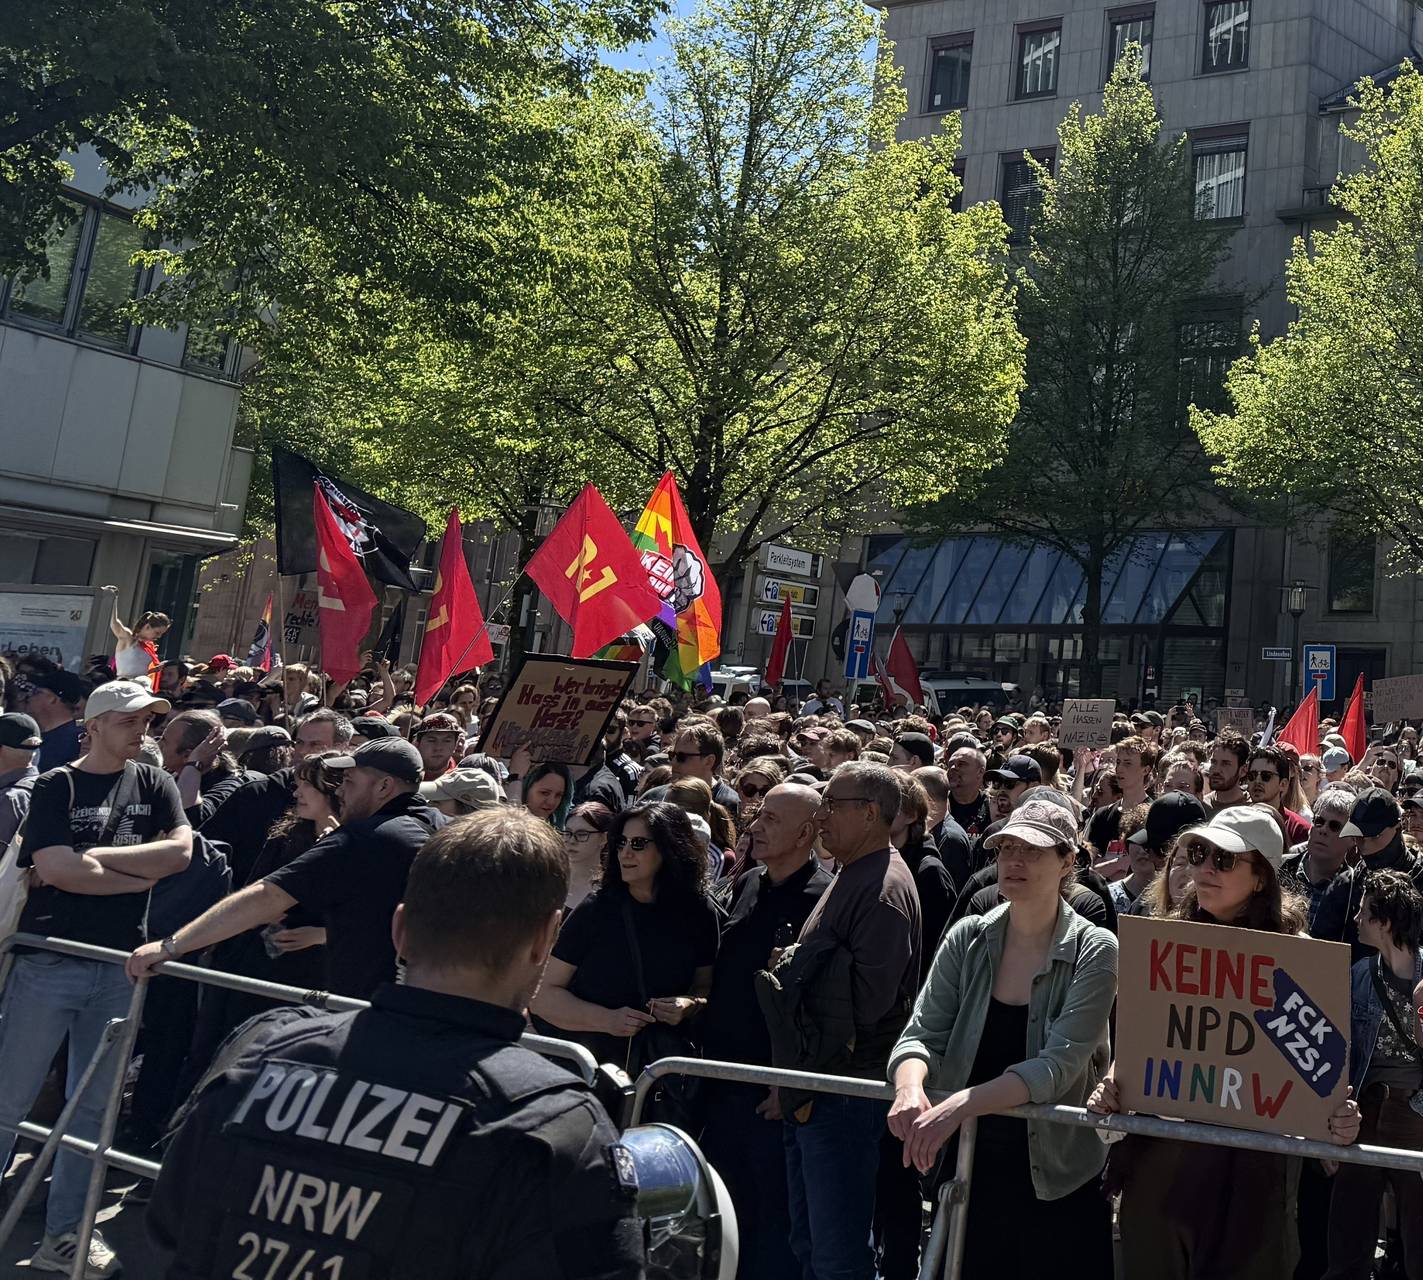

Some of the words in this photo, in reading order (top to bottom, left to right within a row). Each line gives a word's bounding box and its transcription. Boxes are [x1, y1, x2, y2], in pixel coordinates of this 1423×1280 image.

[770, 551, 806, 569] Parkleitsystem
[517, 684, 561, 708] Hass
[562, 696, 581, 710] in
[1068, 702, 1099, 712] ALLE
[1072, 714, 1102, 724] HASSEN
[1063, 731, 1098, 743] NAZIS
[1149, 938, 1276, 1008] KEINE
[1166, 1003, 1256, 1056] NPD
[1282, 991, 1333, 1045] FCK
[1266, 1015, 1332, 1082] NZS!
[233, 1063, 464, 1168] POLIZEI
[248, 1164, 383, 1241] NRW
